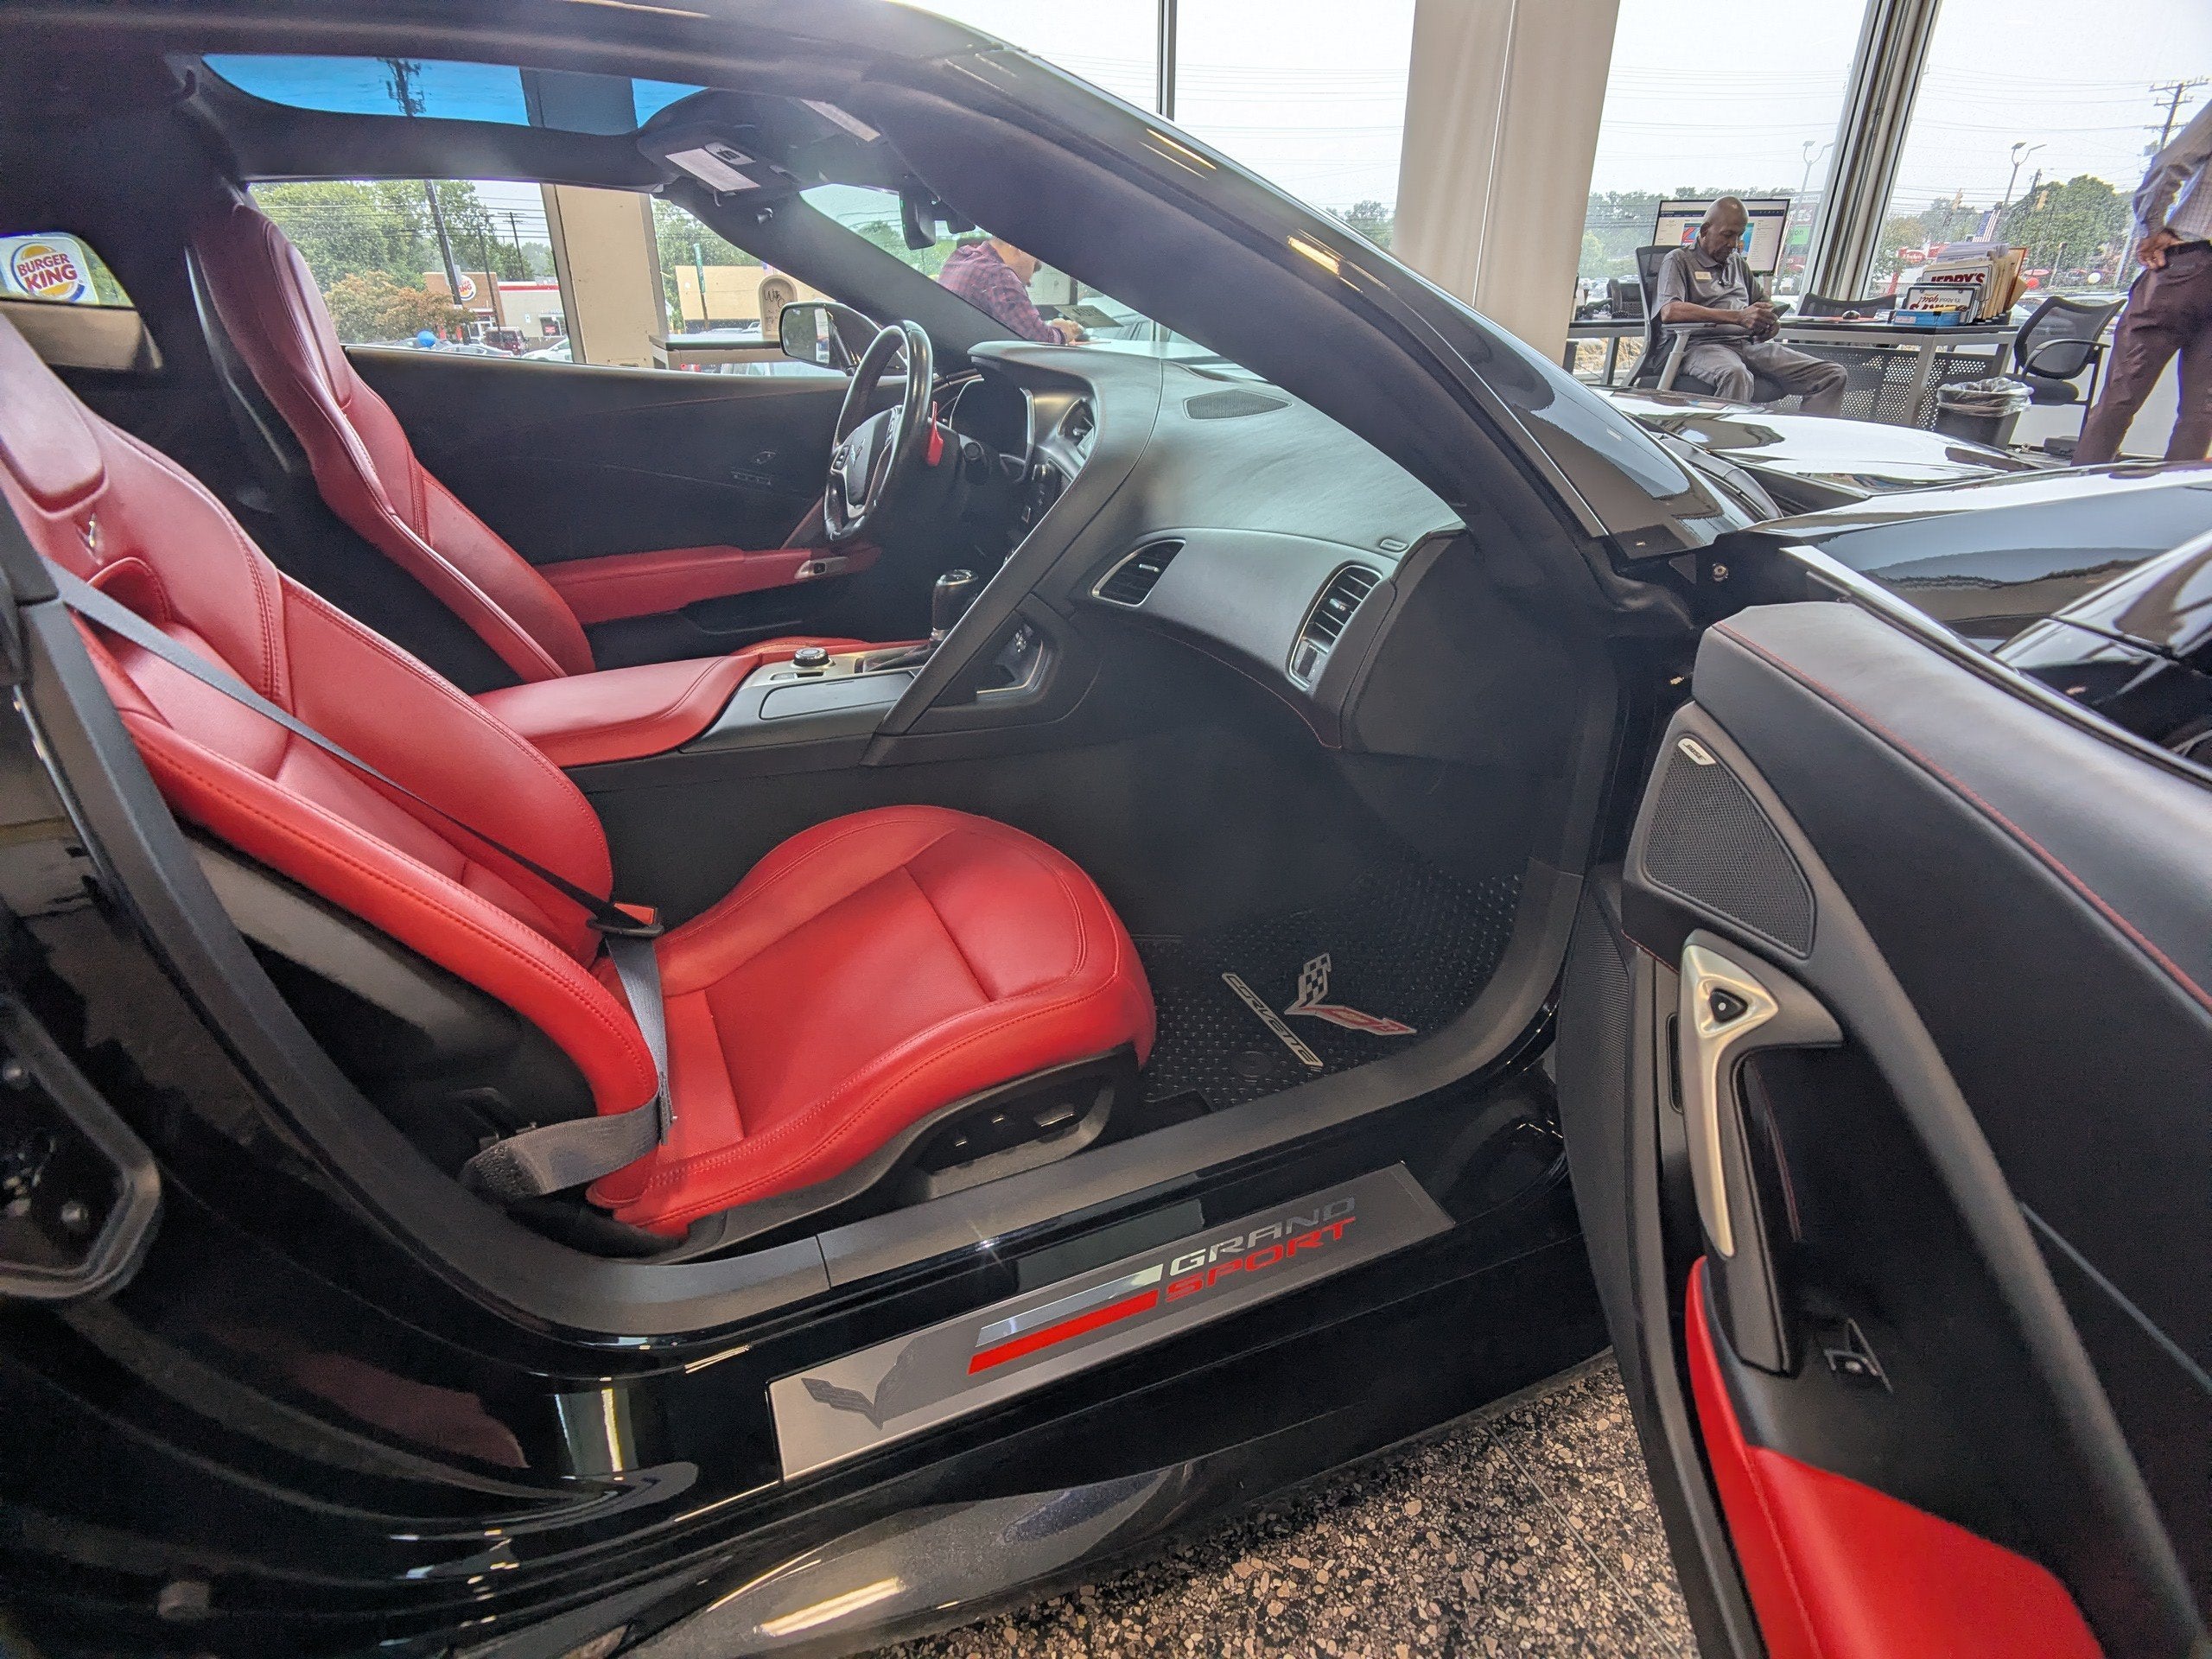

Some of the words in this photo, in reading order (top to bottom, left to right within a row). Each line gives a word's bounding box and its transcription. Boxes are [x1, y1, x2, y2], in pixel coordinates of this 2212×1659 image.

[17, 253, 71, 276] BURGER
[24, 264, 78, 290] KING
[1225, 975, 1319, 1063] CORVETTE
[1166, 1216, 1356, 1302] SPORT
[1169, 1196, 1356, 1276] GRAND
